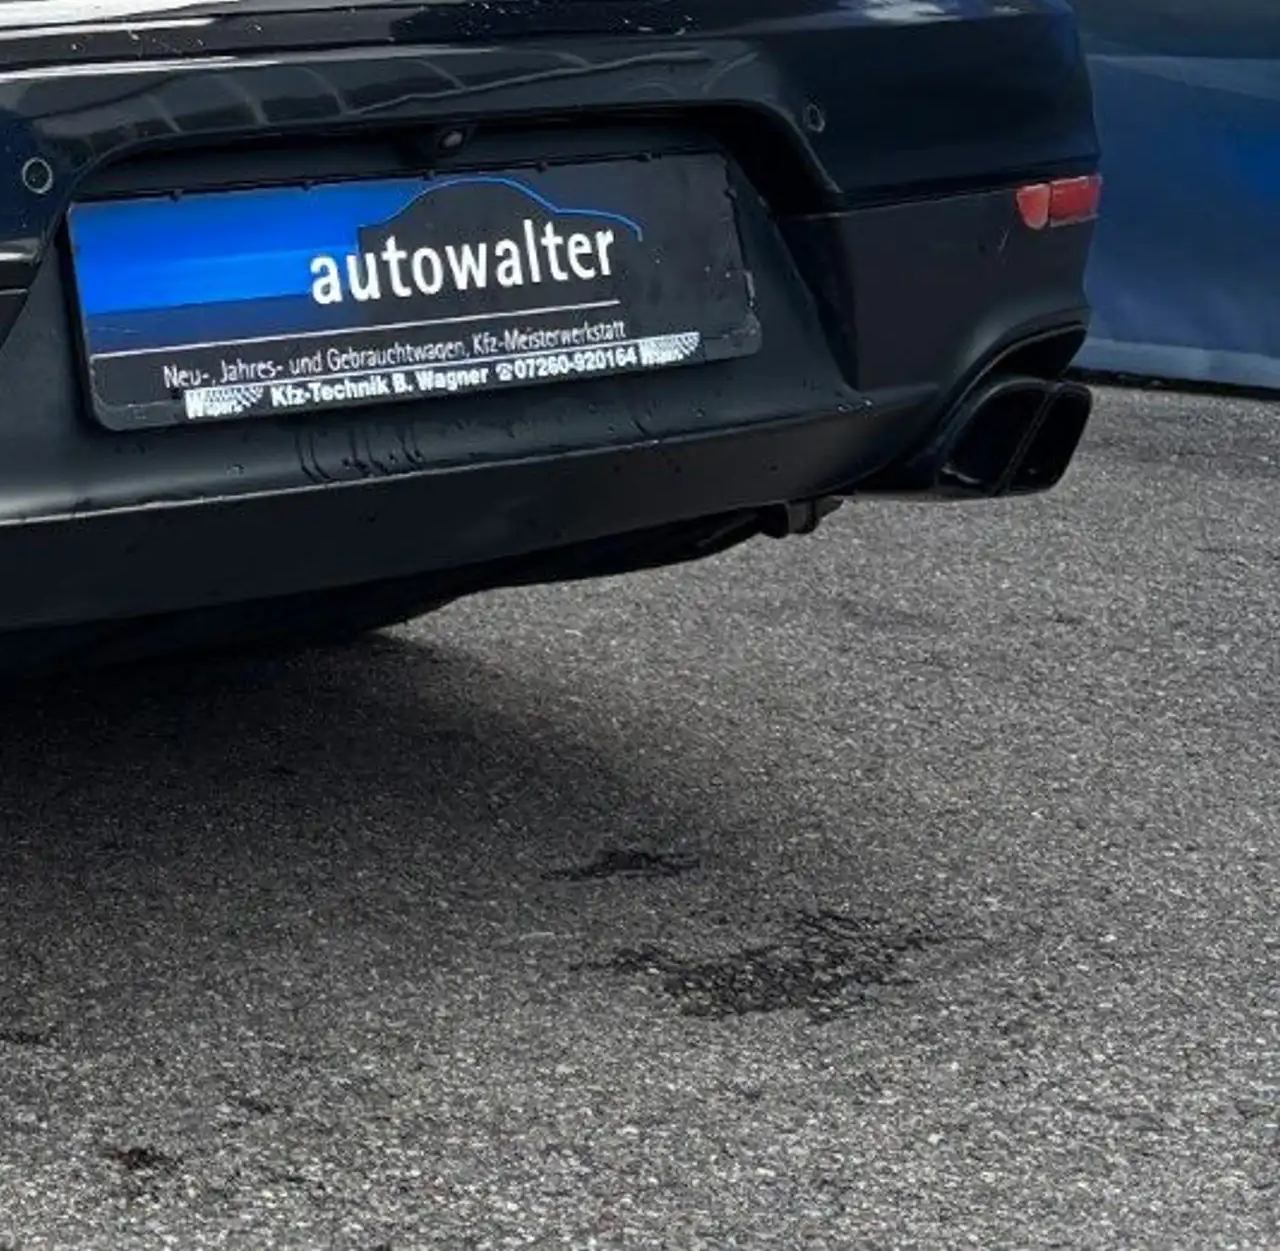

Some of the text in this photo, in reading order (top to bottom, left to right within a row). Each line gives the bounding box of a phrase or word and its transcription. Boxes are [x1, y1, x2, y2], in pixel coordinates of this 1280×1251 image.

[310, 219, 616, 304] autowalter
[220, 358, 283, 384] Jahres-
[290, 350, 322, 374] und
[472, 320, 627, 356] Kfz-Meisterwerkstatt
[270, 375, 391, 408] Kfz-Technik
[393, 373, 413, 393] B.
[417, 366, 489, 392] Wagner
